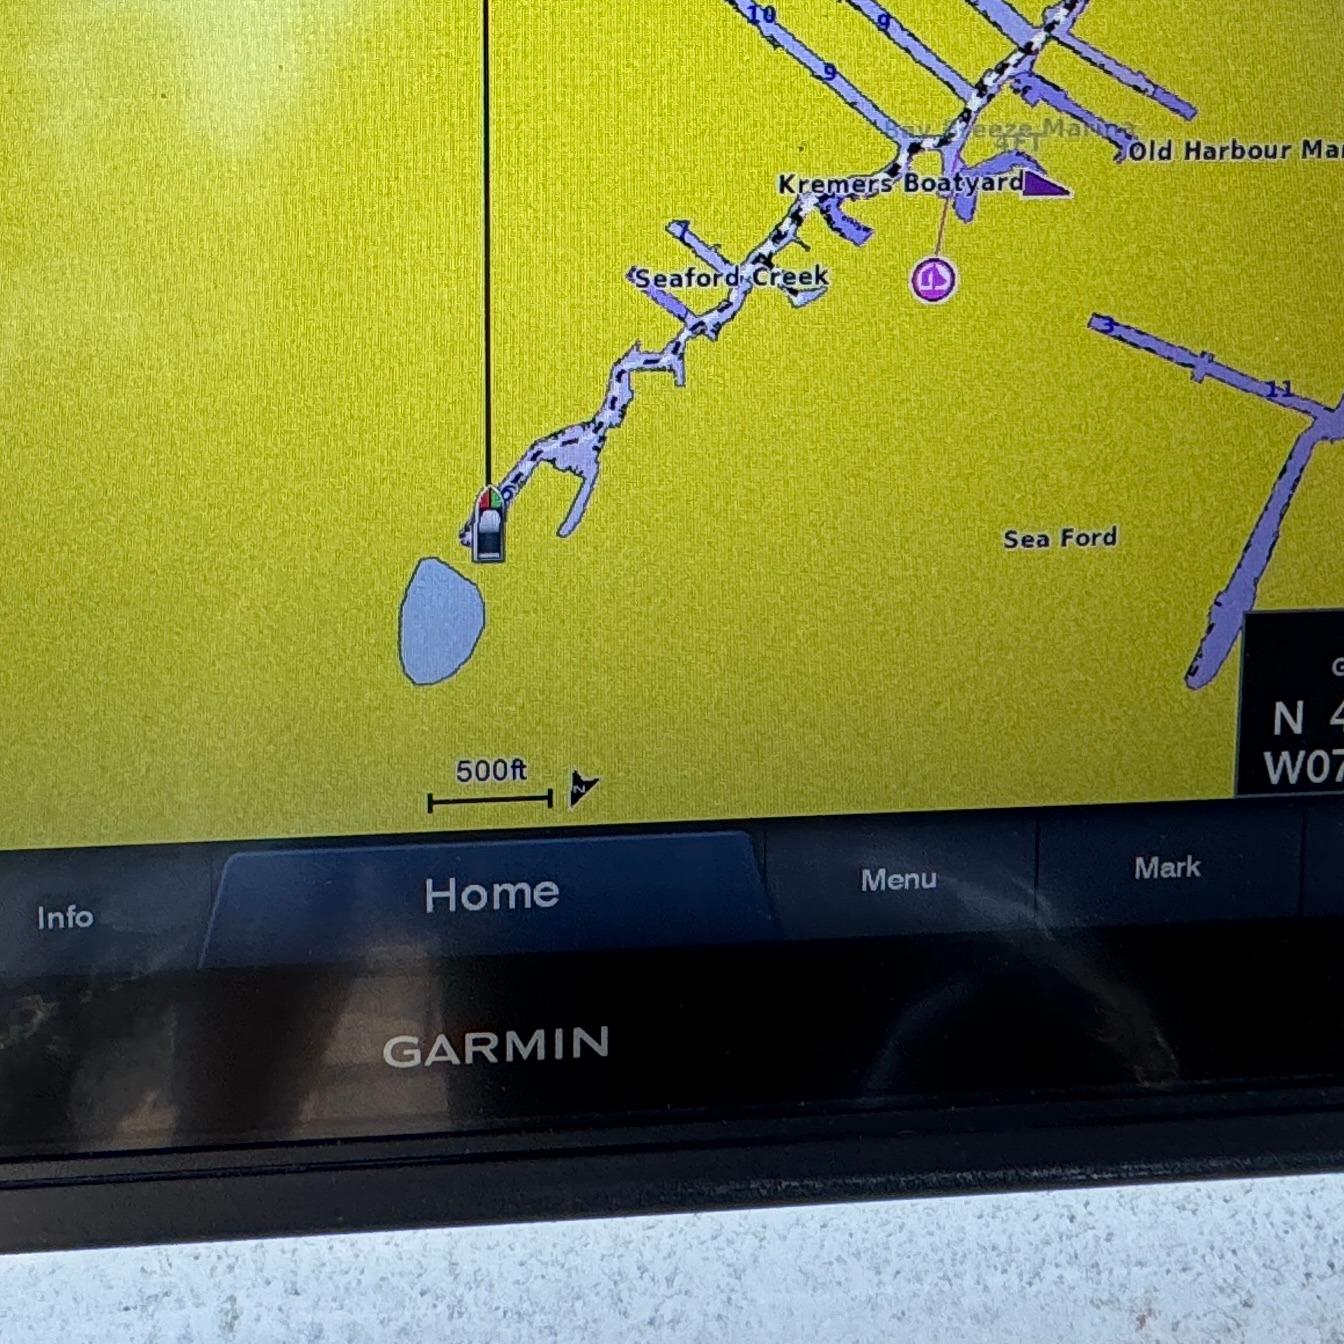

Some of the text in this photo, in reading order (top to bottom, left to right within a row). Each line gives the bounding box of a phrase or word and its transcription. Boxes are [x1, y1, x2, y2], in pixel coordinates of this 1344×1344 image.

[877, 14, 891, 32] 9
[824, 62, 837, 81] 9
[1129, 138, 1174, 161] Old
[1185, 138, 1293, 162] Harbour
[779, 171, 1023, 197] Kremers Boatyard
[635, 264, 829, 289] Seaford Creek
[1266, 380, 1293, 398] 11
[1004, 526, 1118, 550] Sea Ford
[1274, 701, 1303, 735] N
[455, 757, 529, 785] 500ft
[861, 866, 938, 894] Menu
[1134, 855, 1201, 881] Mark
[424, 876, 560, 913] Home
[37, 903, 95, 930] Info
[383, 1025, 610, 1069] GARMIN
